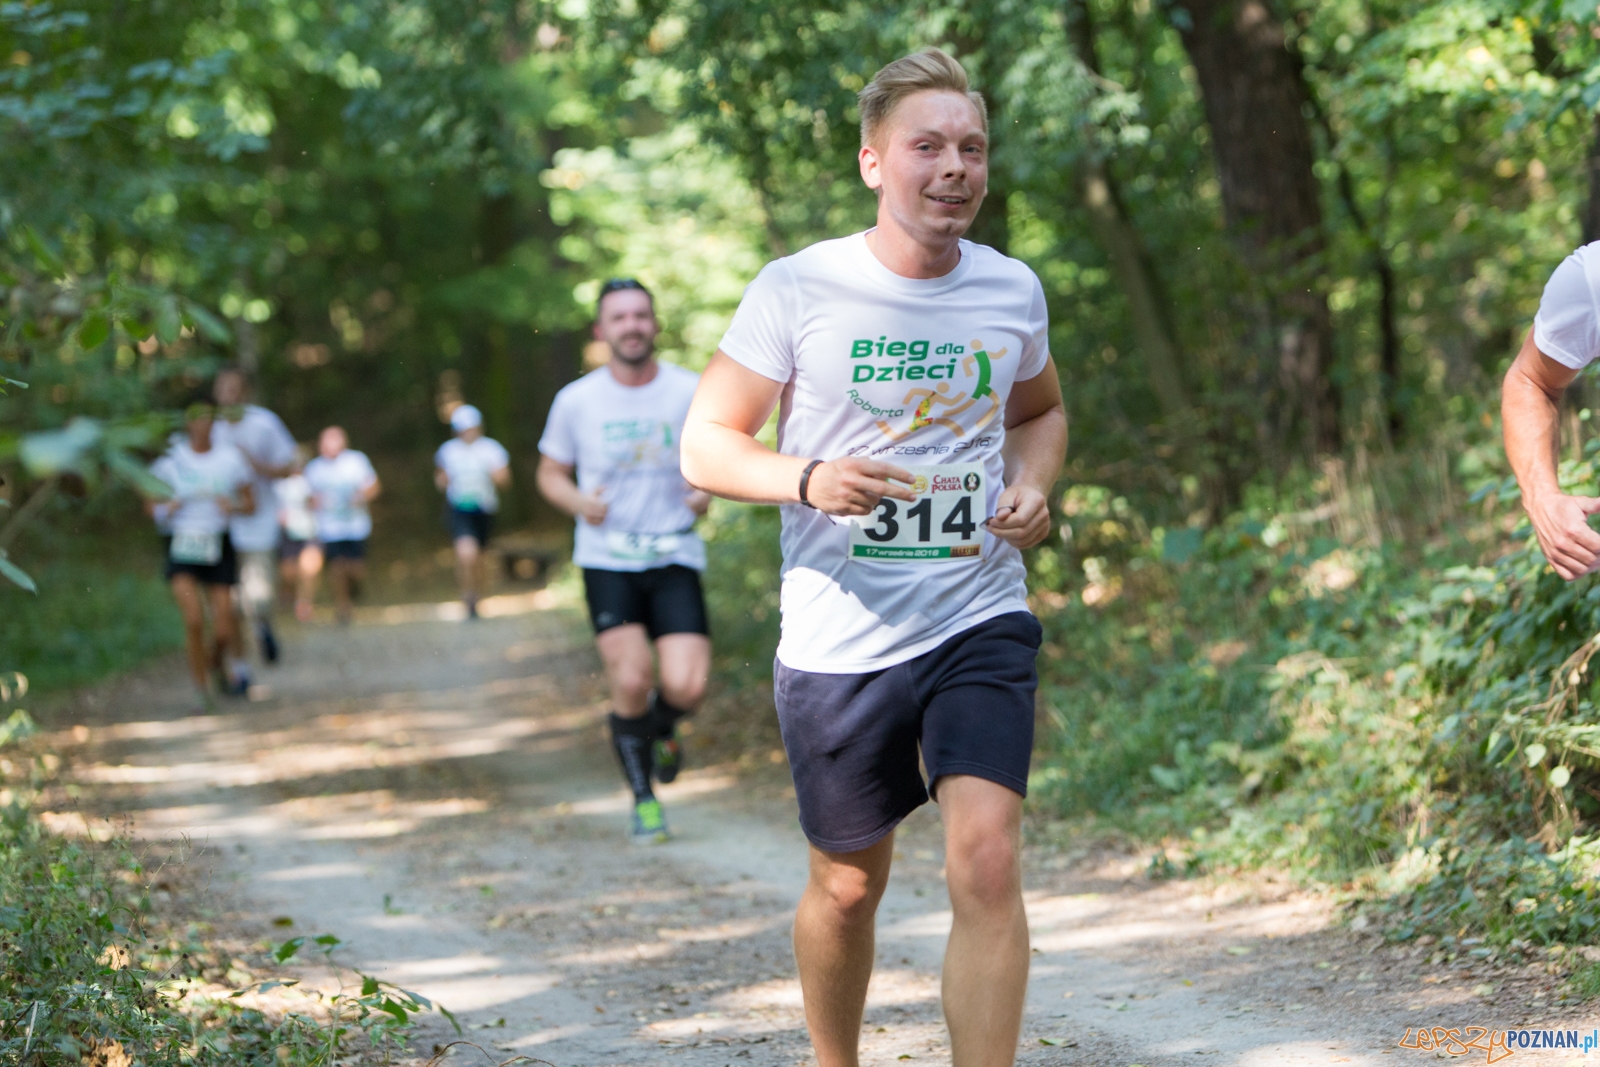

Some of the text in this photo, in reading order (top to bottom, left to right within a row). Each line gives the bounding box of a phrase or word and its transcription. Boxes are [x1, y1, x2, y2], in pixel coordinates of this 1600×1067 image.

[850, 335, 964, 361] Bieg dla
[852, 358, 957, 383] Dzieci
[846, 389, 904, 418] Roberta
[871, 443, 950, 457] września
[931, 483, 962, 494] POLSKA
[933, 474, 961, 485] CHATA
[863, 496, 976, 542] 314
[865, 548, 878, 556] 17
